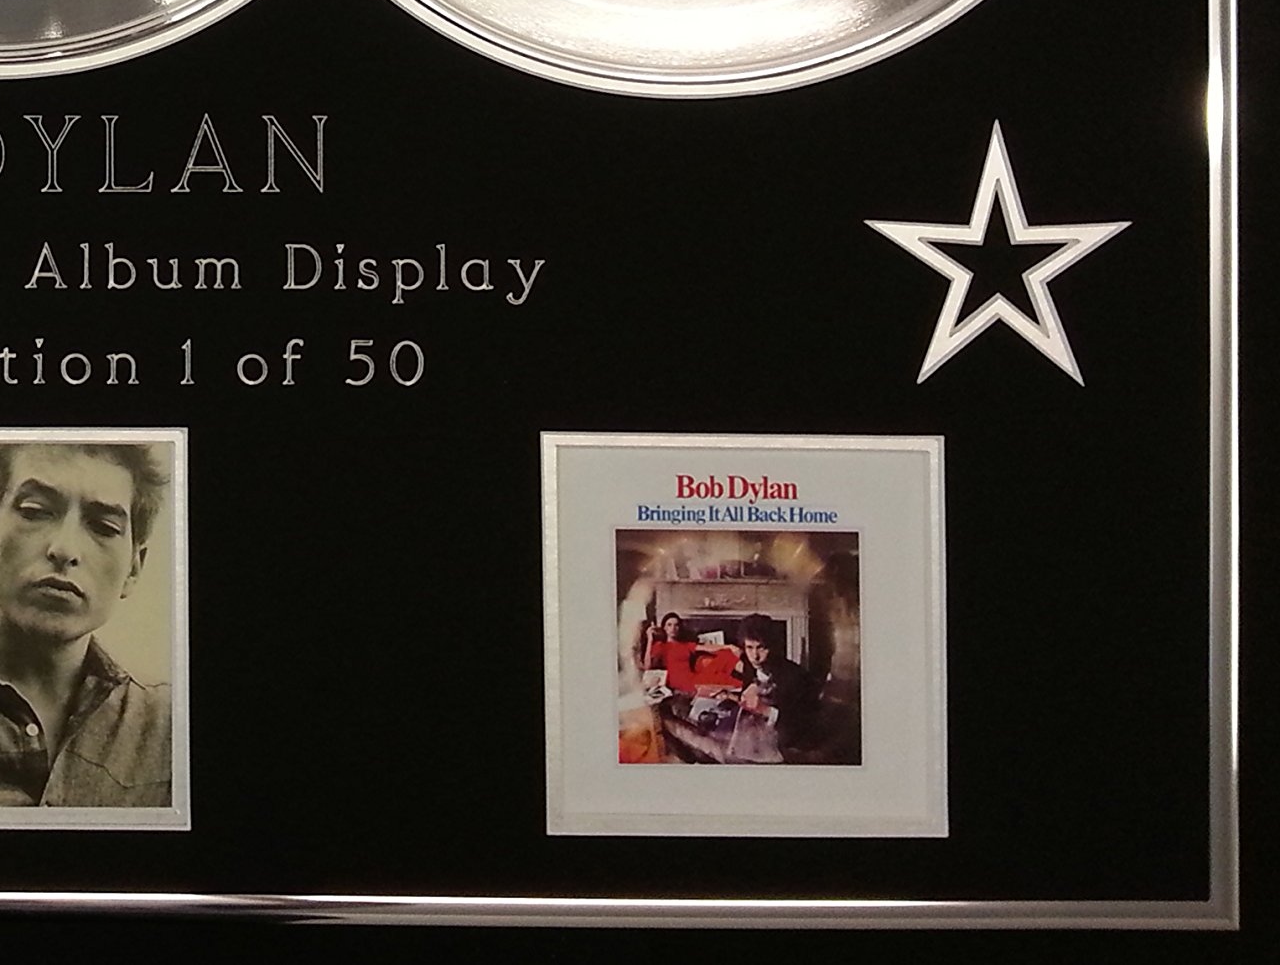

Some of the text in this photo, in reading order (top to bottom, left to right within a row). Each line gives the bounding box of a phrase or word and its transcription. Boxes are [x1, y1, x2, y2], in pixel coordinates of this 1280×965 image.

[23, 241, 242, 290] Album
[282, 243, 546, 306] Display
[179, 338, 195, 385] 1
[236, 338, 305, 386] of
[344, 339, 425, 387] 50
[676, 474, 798, 504] Bob Dylan
[637, 505, 838, 524] Bringing It All Back Home
